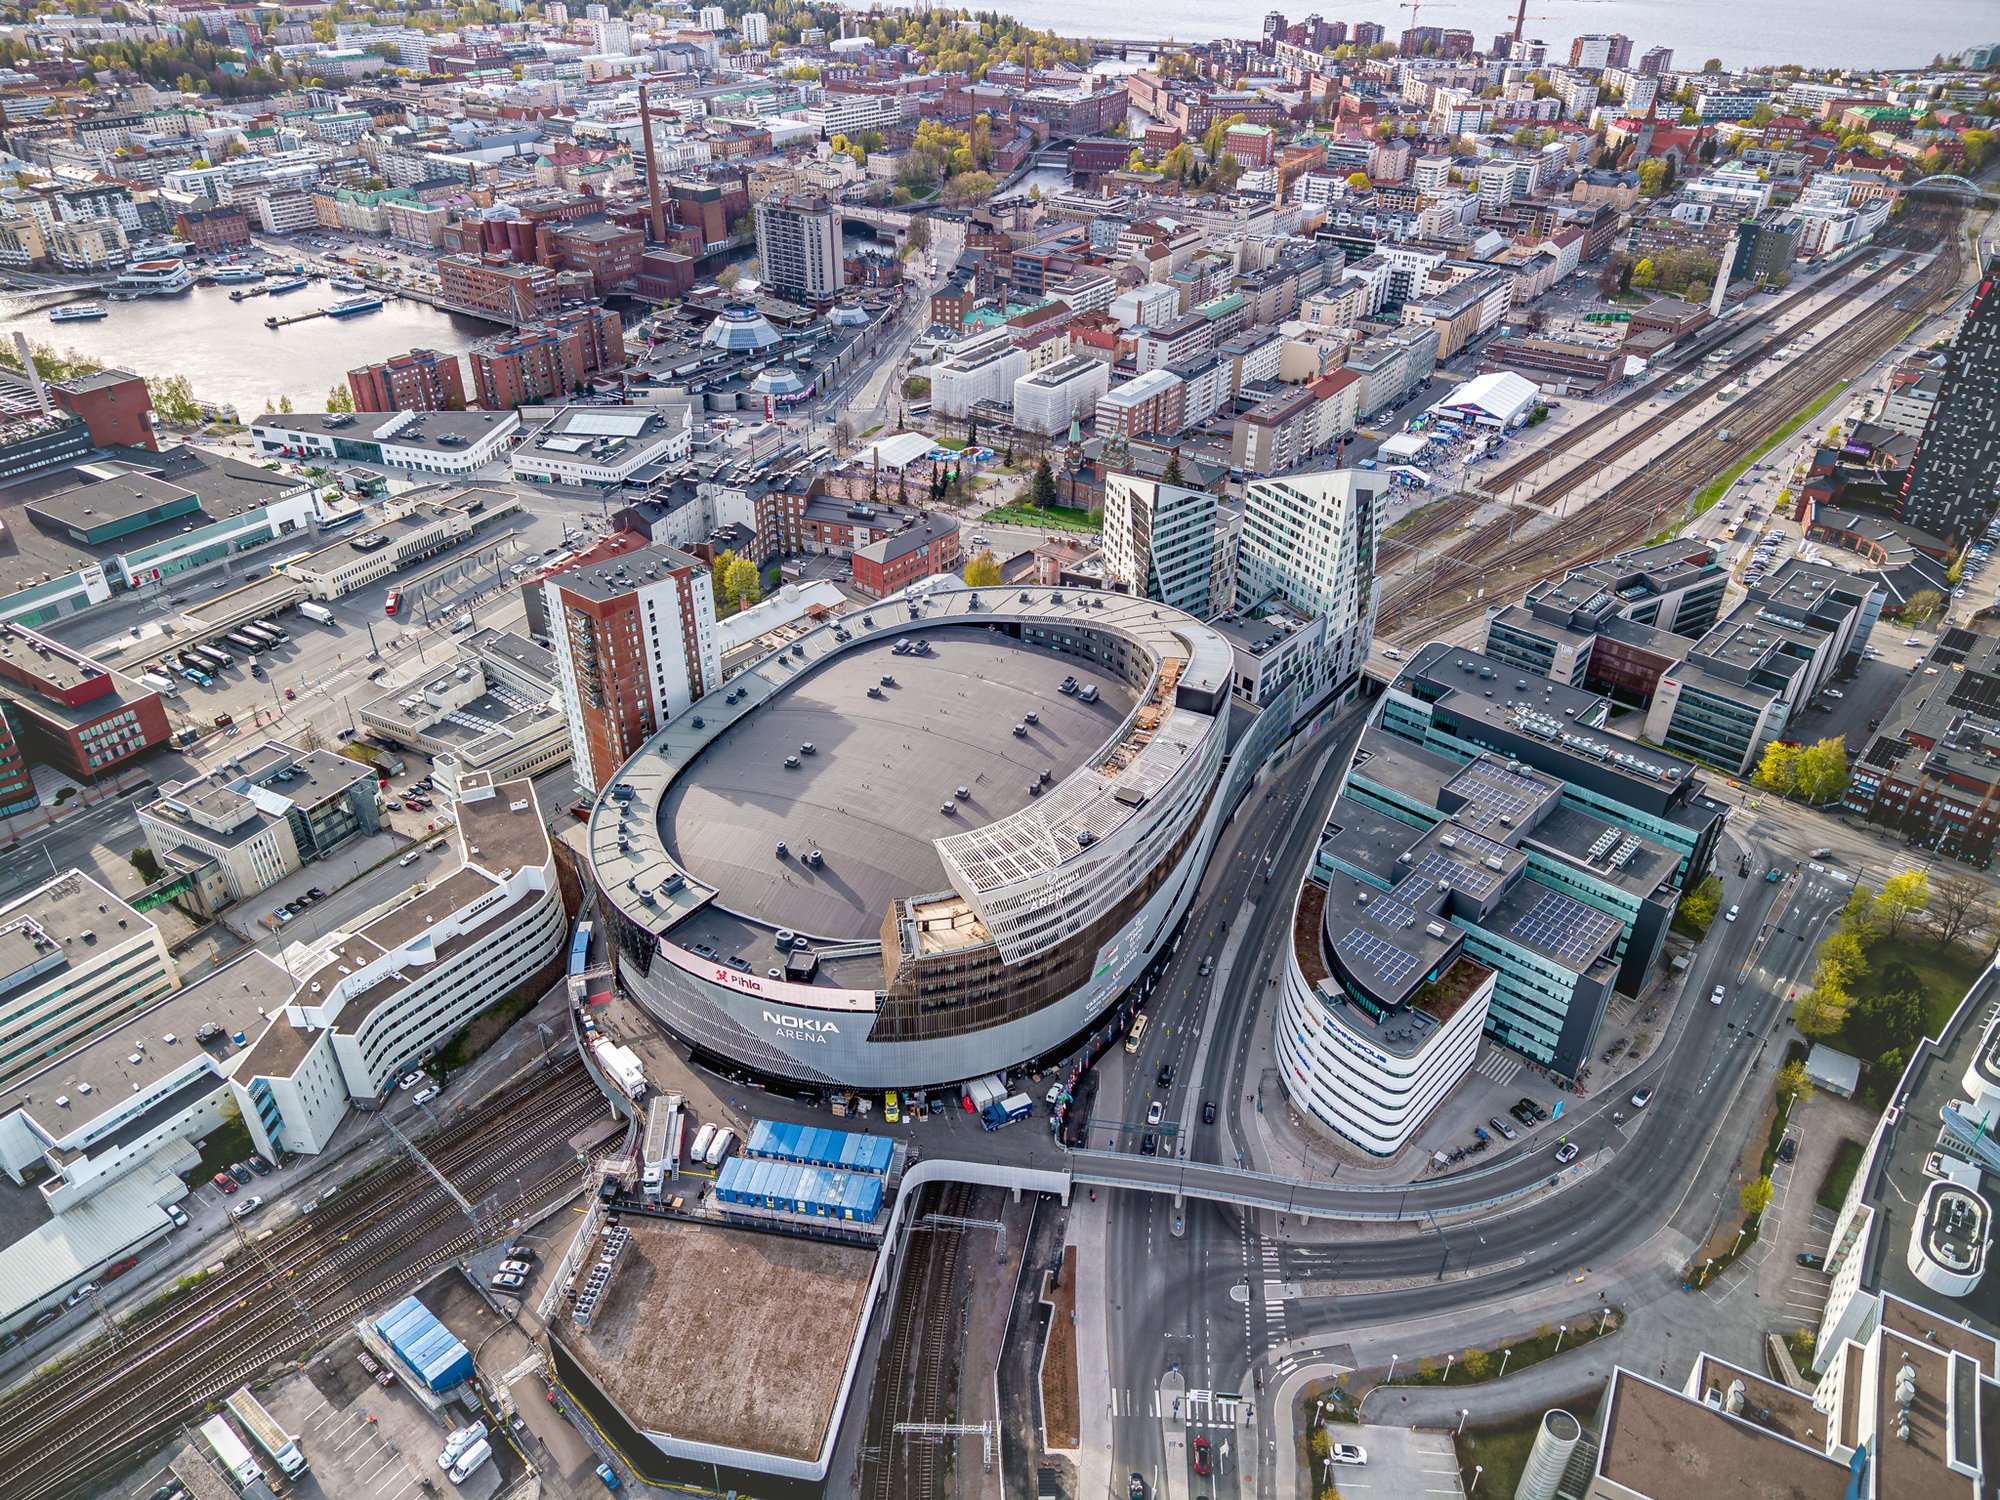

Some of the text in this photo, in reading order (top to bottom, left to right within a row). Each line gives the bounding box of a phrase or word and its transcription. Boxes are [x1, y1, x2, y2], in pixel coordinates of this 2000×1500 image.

[280, 483, 311, 499] RATINA
[1029, 886, 1072, 913] ARENA
[731, 975, 761, 991] Pihla
[763, 1010, 840, 1034] NOKIA
[776, 1027, 827, 1044] ARENA
[1323, 1015, 1387, 1063] TECHNOPOLIS
